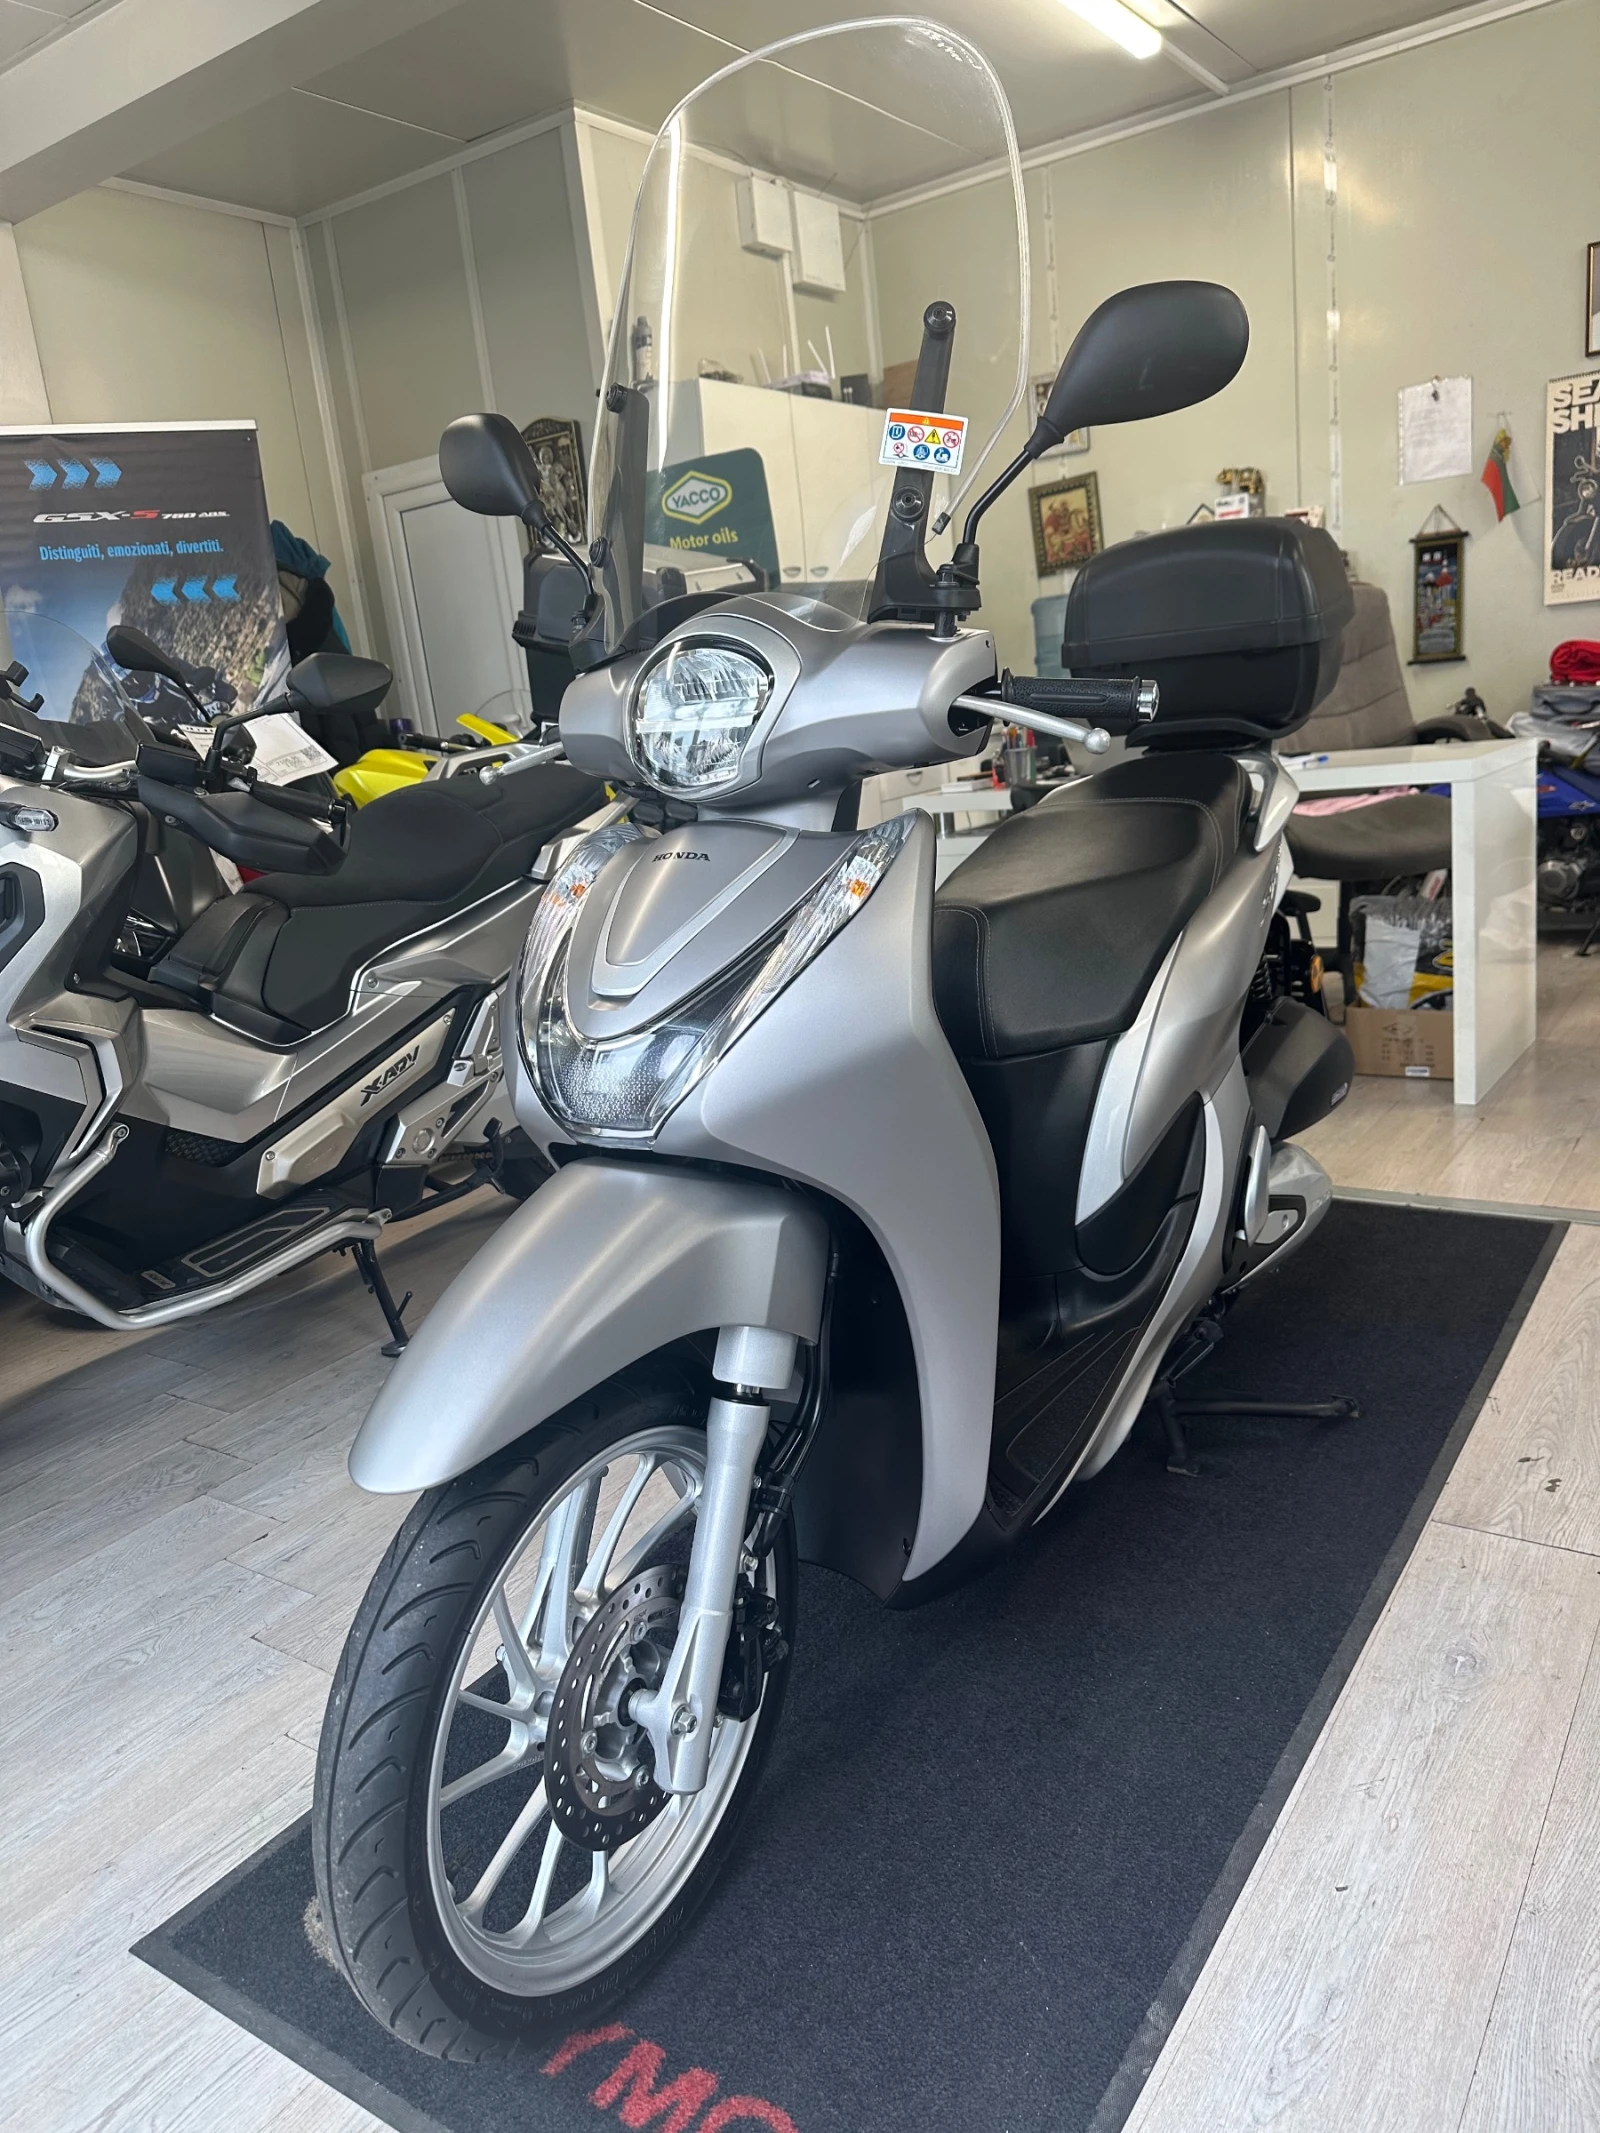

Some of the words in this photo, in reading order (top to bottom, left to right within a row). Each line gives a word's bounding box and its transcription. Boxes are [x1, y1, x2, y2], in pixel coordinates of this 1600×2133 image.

[672, 487, 721, 508] YACCO
[33, 510, 160, 523] GSX-S
[670, 535, 709, 550] Motor
[712, 526, 739, 545] oils
[39, 544, 105, 563] Distinguiti,
[107, 541, 174, 558] emozionati,
[176, 539, 224, 554] divertiti.
[652, 851, 711, 863] HONDA
